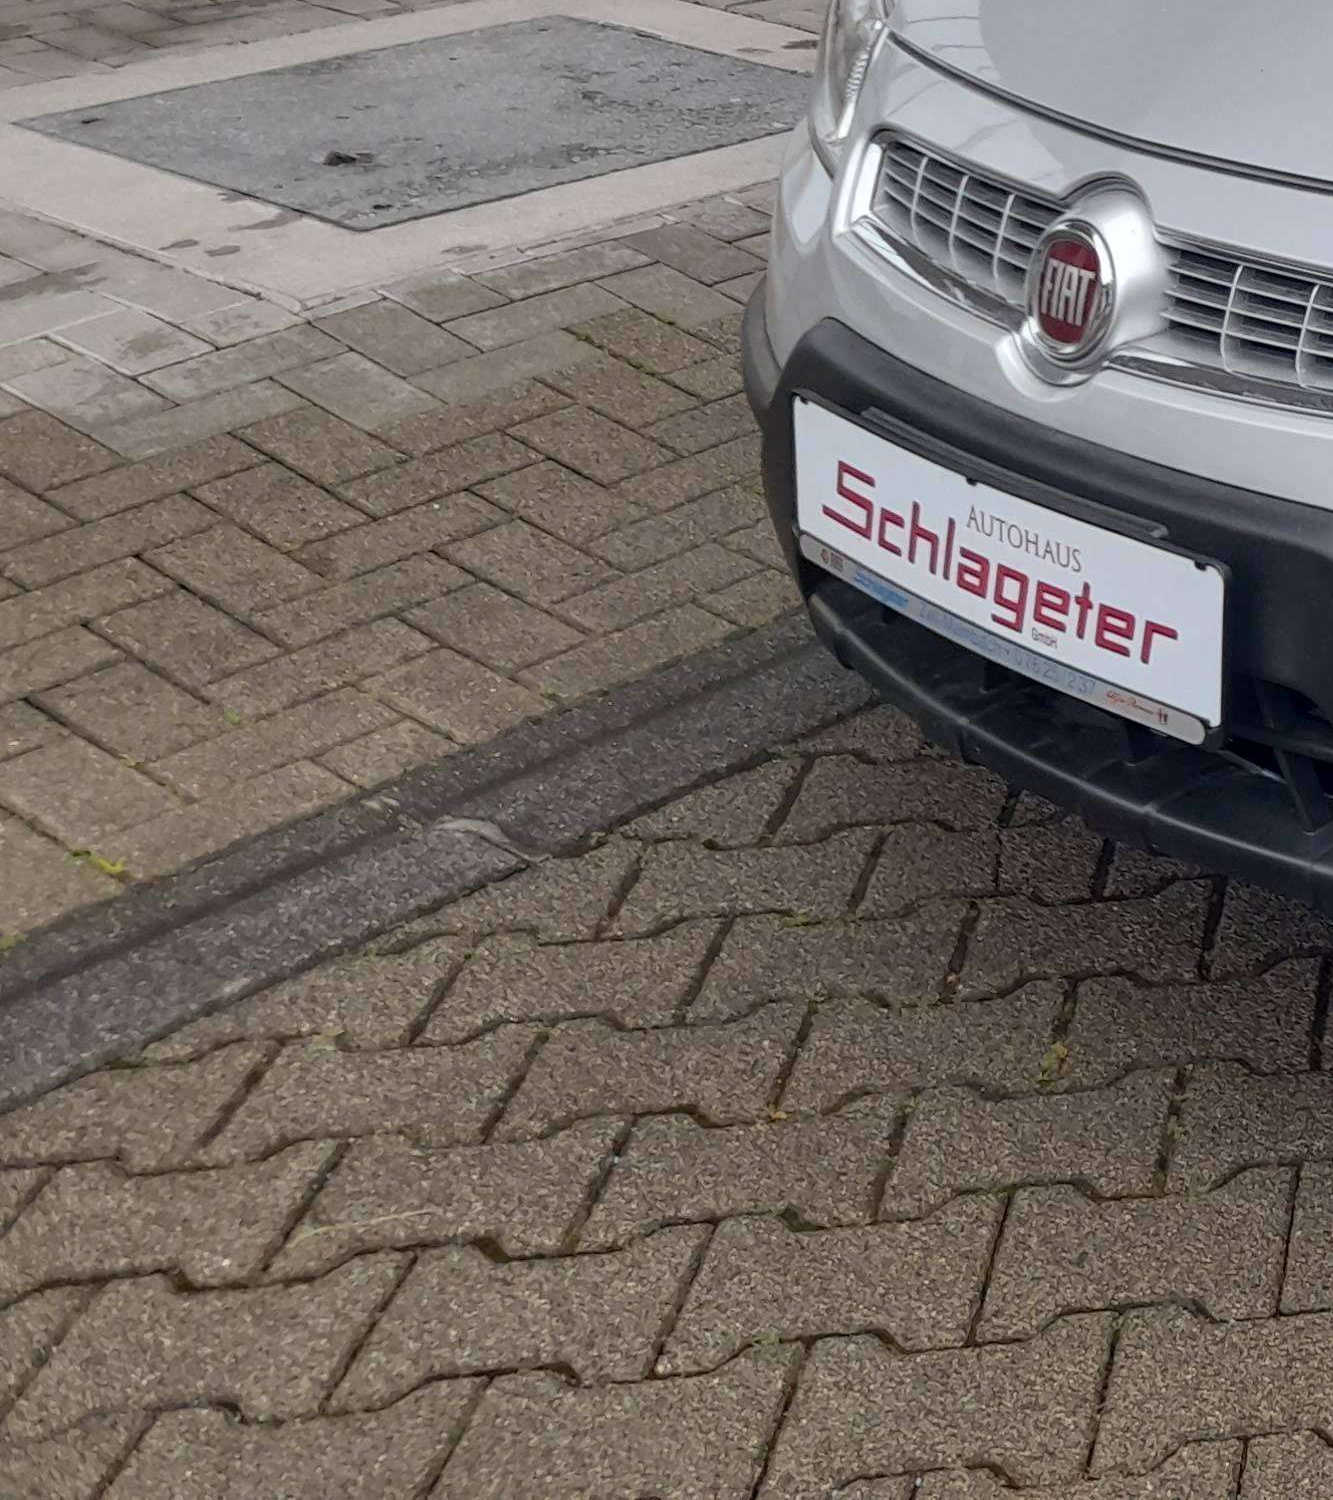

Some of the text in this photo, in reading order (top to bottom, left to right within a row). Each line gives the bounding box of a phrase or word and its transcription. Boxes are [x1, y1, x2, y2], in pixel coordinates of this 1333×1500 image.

[1040, 257, 1097, 327] FIAT
[821, 459, 1179, 665] Schlageter
[966, 504, 1083, 573] AUTOHAUS
